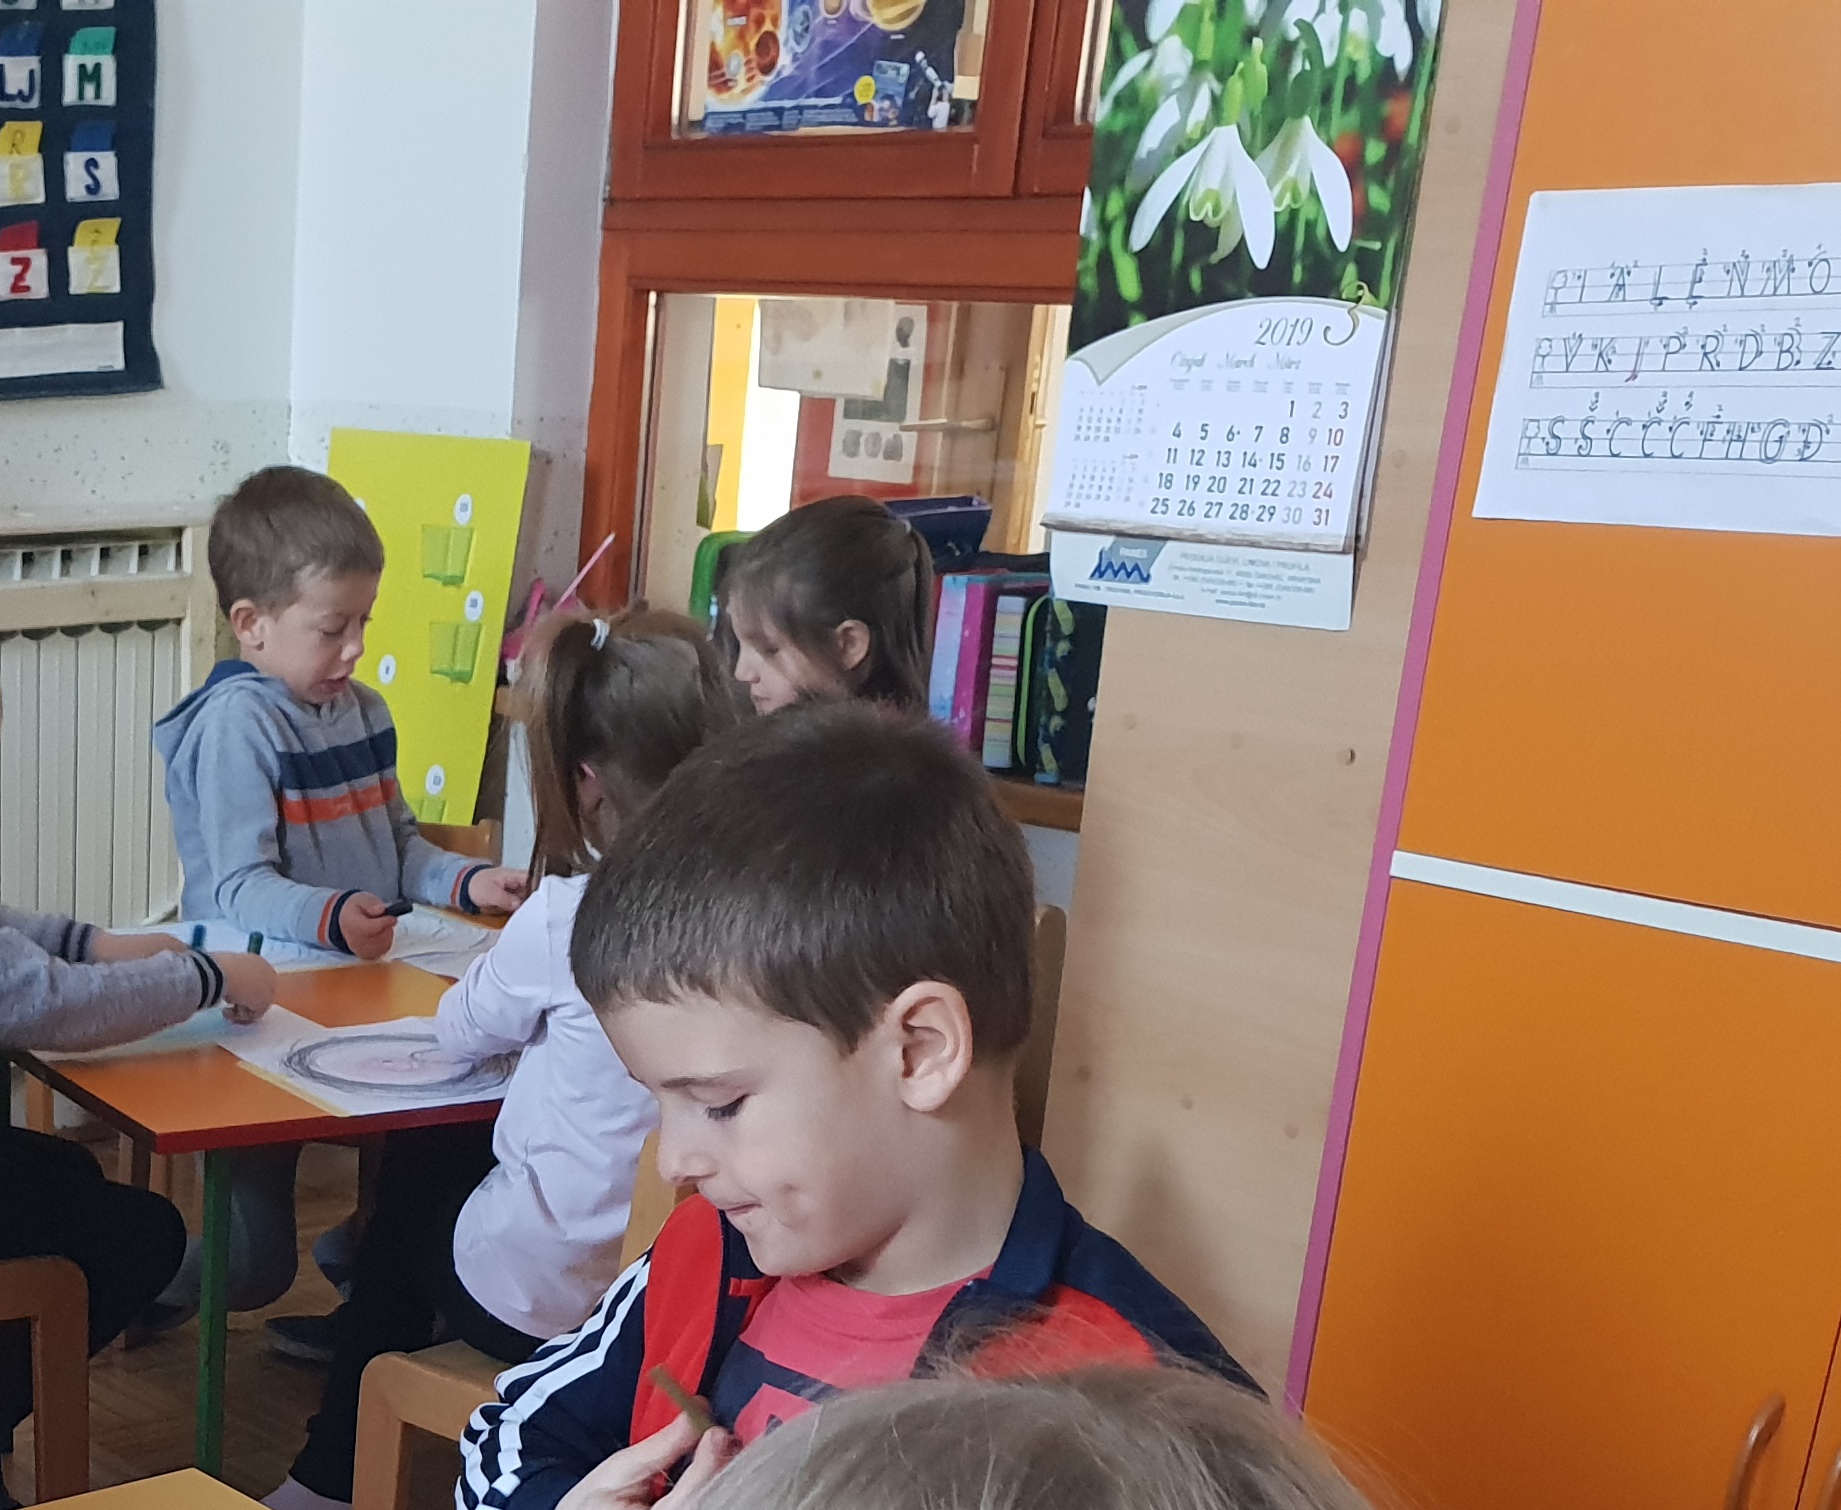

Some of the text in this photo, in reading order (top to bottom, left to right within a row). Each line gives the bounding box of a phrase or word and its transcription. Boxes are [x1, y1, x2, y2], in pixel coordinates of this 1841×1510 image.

[77, 63, 102, 100] M
[84, 158, 102, 196] S
[10, 257, 32, 294] Z
[1255, 317, 1314, 346] 2019
[1661, 335, 1682, 372] P
[1699, 334, 1721, 371] R
[1776, 332, 1798, 370] B
[1289, 400, 1349, 420] 1 2 3
[1172, 422, 1344, 446] 4 5 6 7 8 9 10
[1166, 448, 1340, 473] 11 12 13 14 15 16 17
[1158, 472, 1333, 499] 18 19 20 21 22 23 24
[1150, 498, 1330, 526] 25 26 27 28 29 30 31
